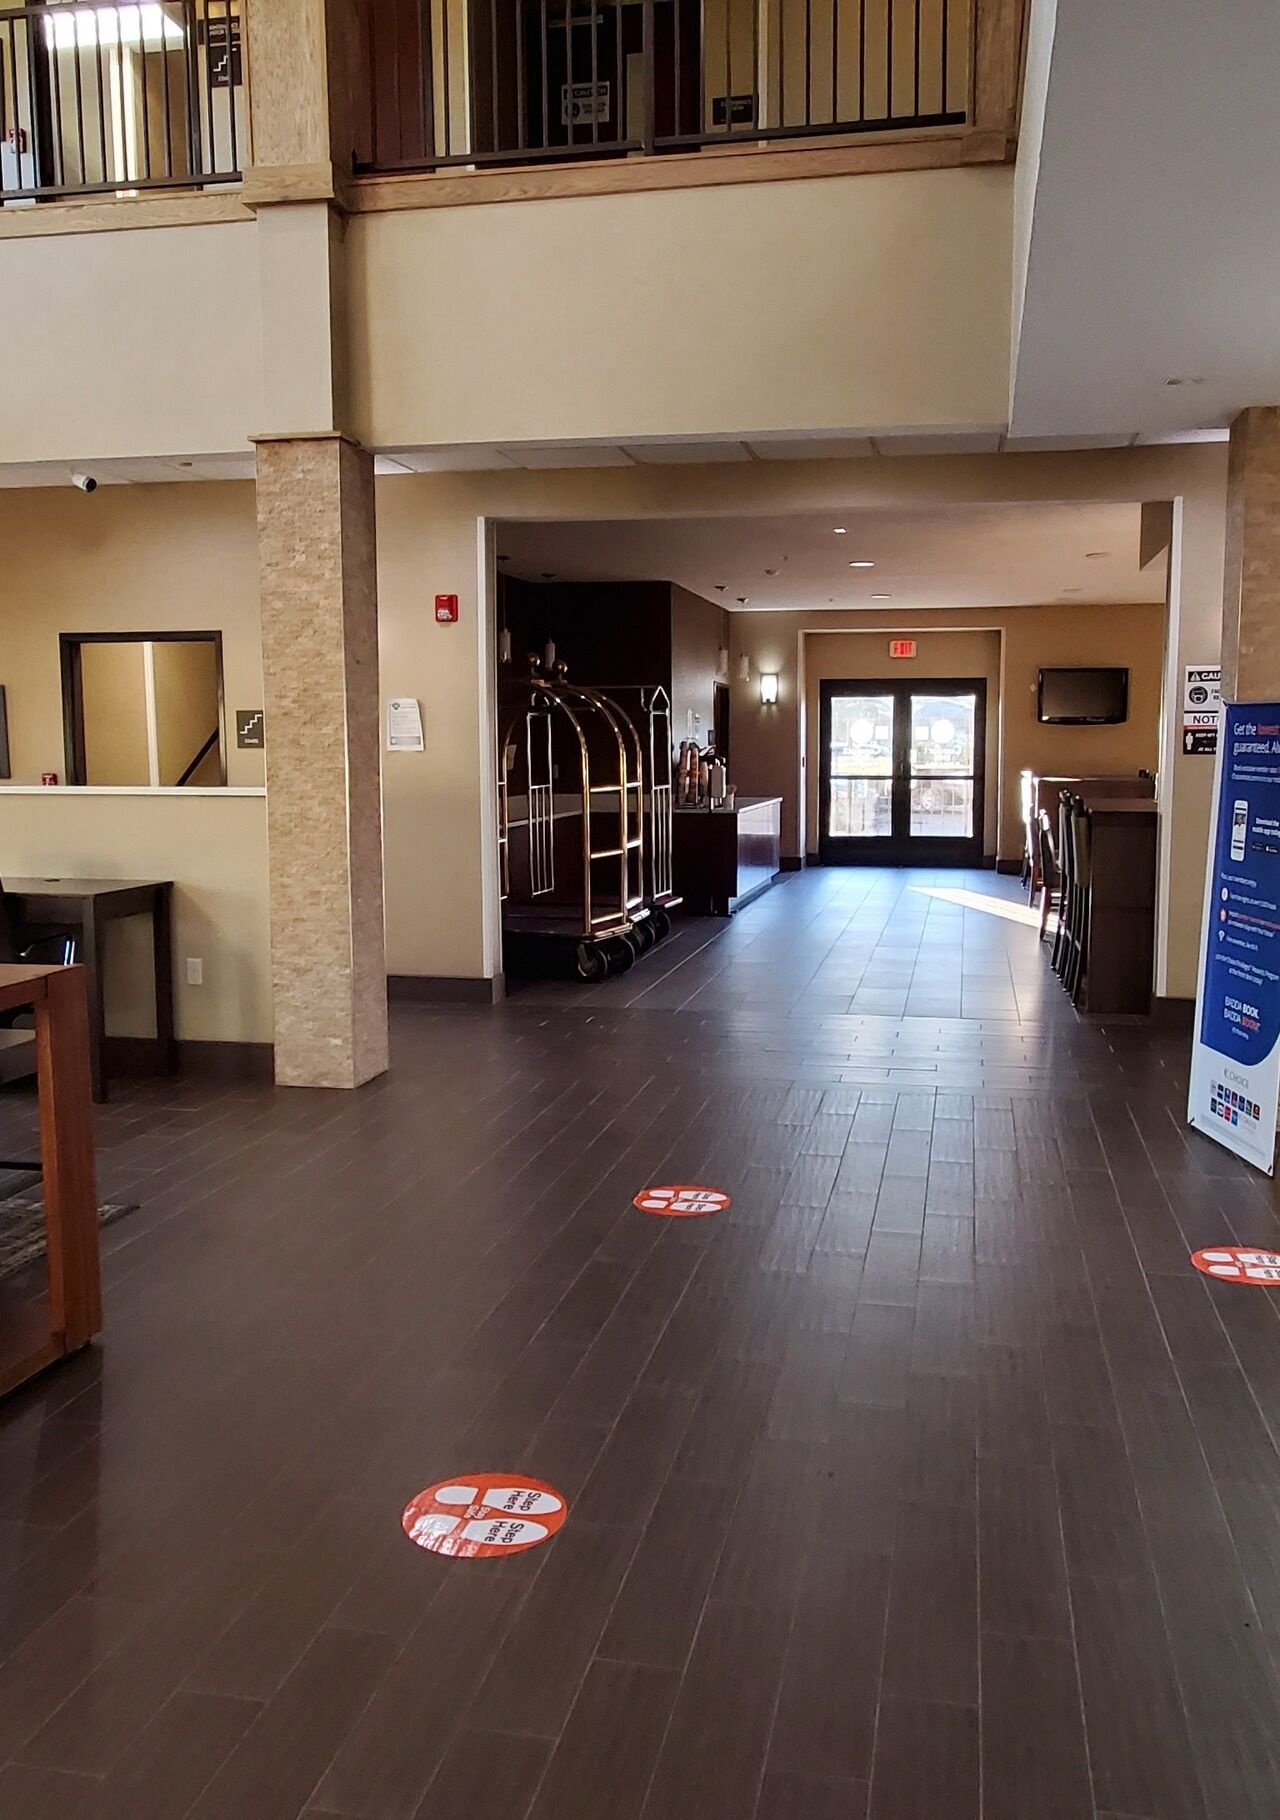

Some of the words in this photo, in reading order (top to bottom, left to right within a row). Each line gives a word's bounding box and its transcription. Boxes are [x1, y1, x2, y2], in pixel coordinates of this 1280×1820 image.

[1234, 722, 1245, 736] Get
[1245, 722, 1257, 736] the
[503, 1490, 526, 1510] Here
[519, 1492, 541, 1512] Step
[484, 1520, 507, 1542] Here
[501, 1522, 525, 1544] Step
